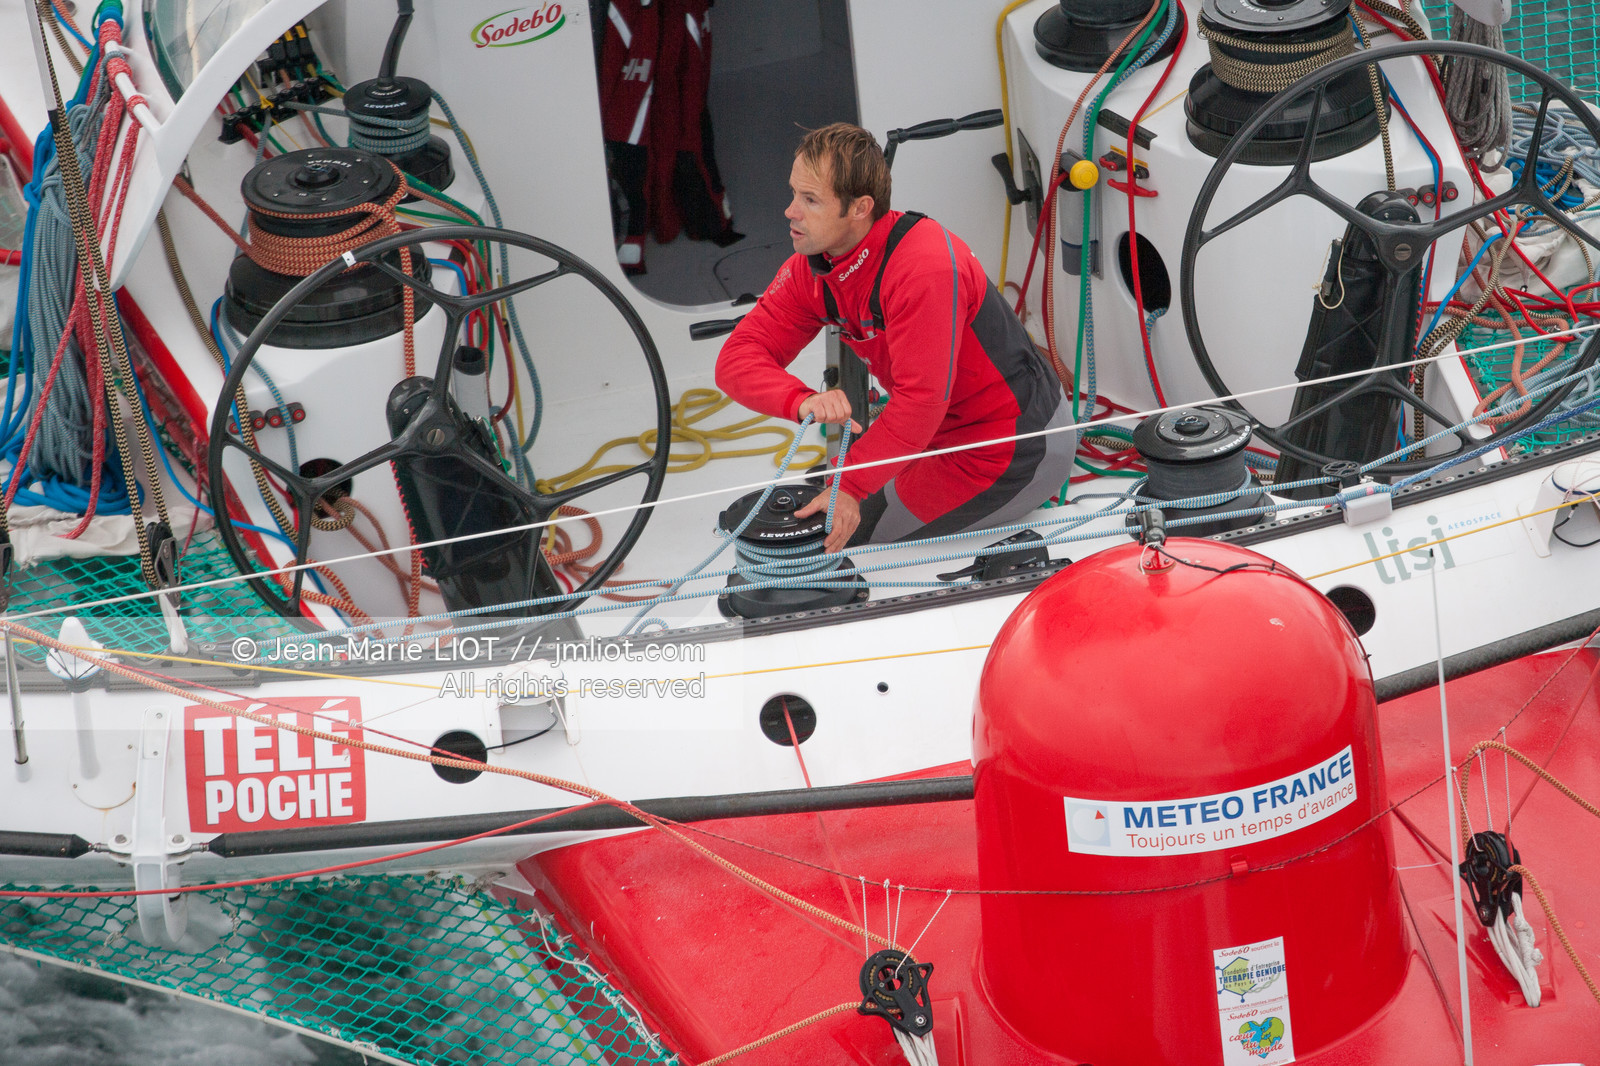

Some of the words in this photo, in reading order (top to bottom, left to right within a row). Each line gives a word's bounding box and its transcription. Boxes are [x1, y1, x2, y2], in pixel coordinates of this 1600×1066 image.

[475, 1, 562, 48] Sodeb'O
[364, 101, 407, 109] LEWMAR
[1448, 511, 1502, 531] AEROSPACE
[759, 529, 810, 538] LEWMAR
[1363, 515, 1456, 585] lisi
[194, 698, 351, 777] TÉLÉ
[1123, 796, 1245, 828] METEO
[1252, 751, 1352, 813] FRANCE
[205, 772, 353, 825] POCHE
[1126, 833, 1206, 851] Toujours
[1213, 827, 1235, 842] un
[1241, 812, 1293, 835] temps
[1251, 942, 1273, 952] soutient
[1219, 971, 1254, 984] THERAPIE
[1256, 964, 1286, 978] GENIQUE
[1223, 966, 1249, 976] Fondation
[1260, 1005, 1283, 1015] soutient
[1229, 1031, 1255, 1042] cœur
[1243, 1040, 1257, 1050] du
[1249, 1042, 1284, 1056] monde
